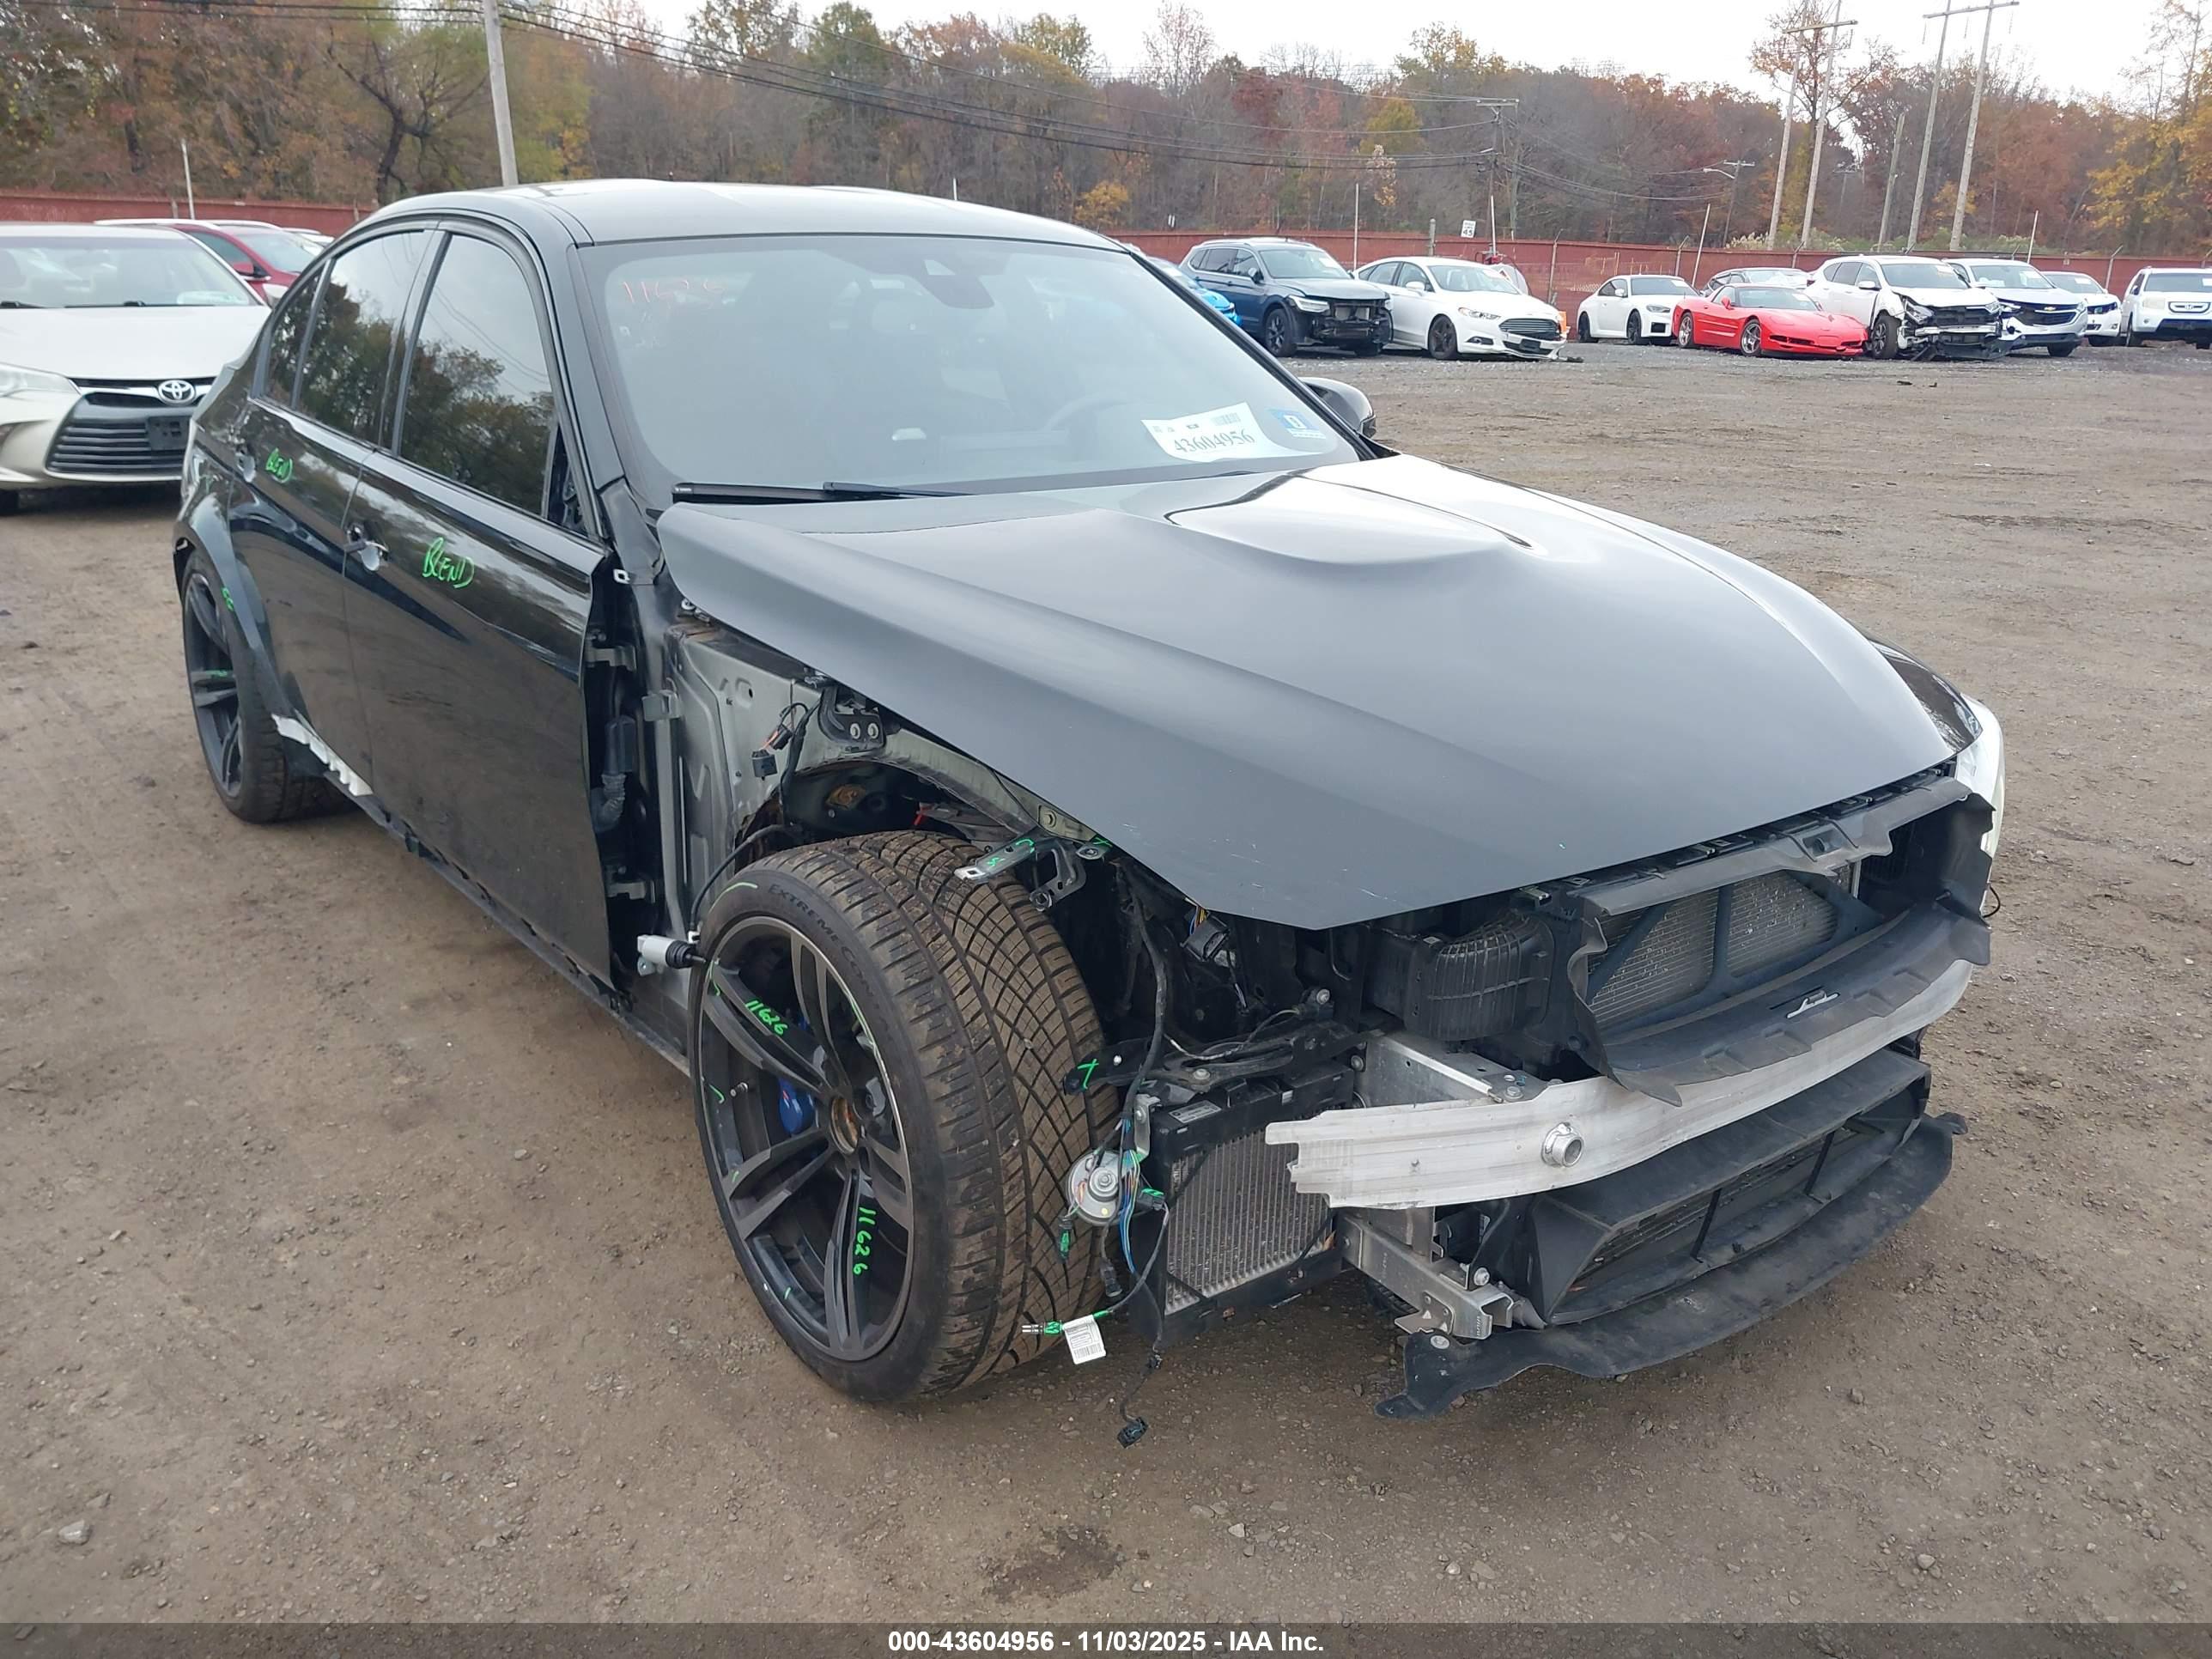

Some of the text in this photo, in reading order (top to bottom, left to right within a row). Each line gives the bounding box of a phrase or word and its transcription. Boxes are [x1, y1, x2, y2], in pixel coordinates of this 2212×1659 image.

[1174, 428, 1255, 453] 43604956
[744, 1000, 788, 1036] 11626
[853, 1206, 876, 1274] 11626
